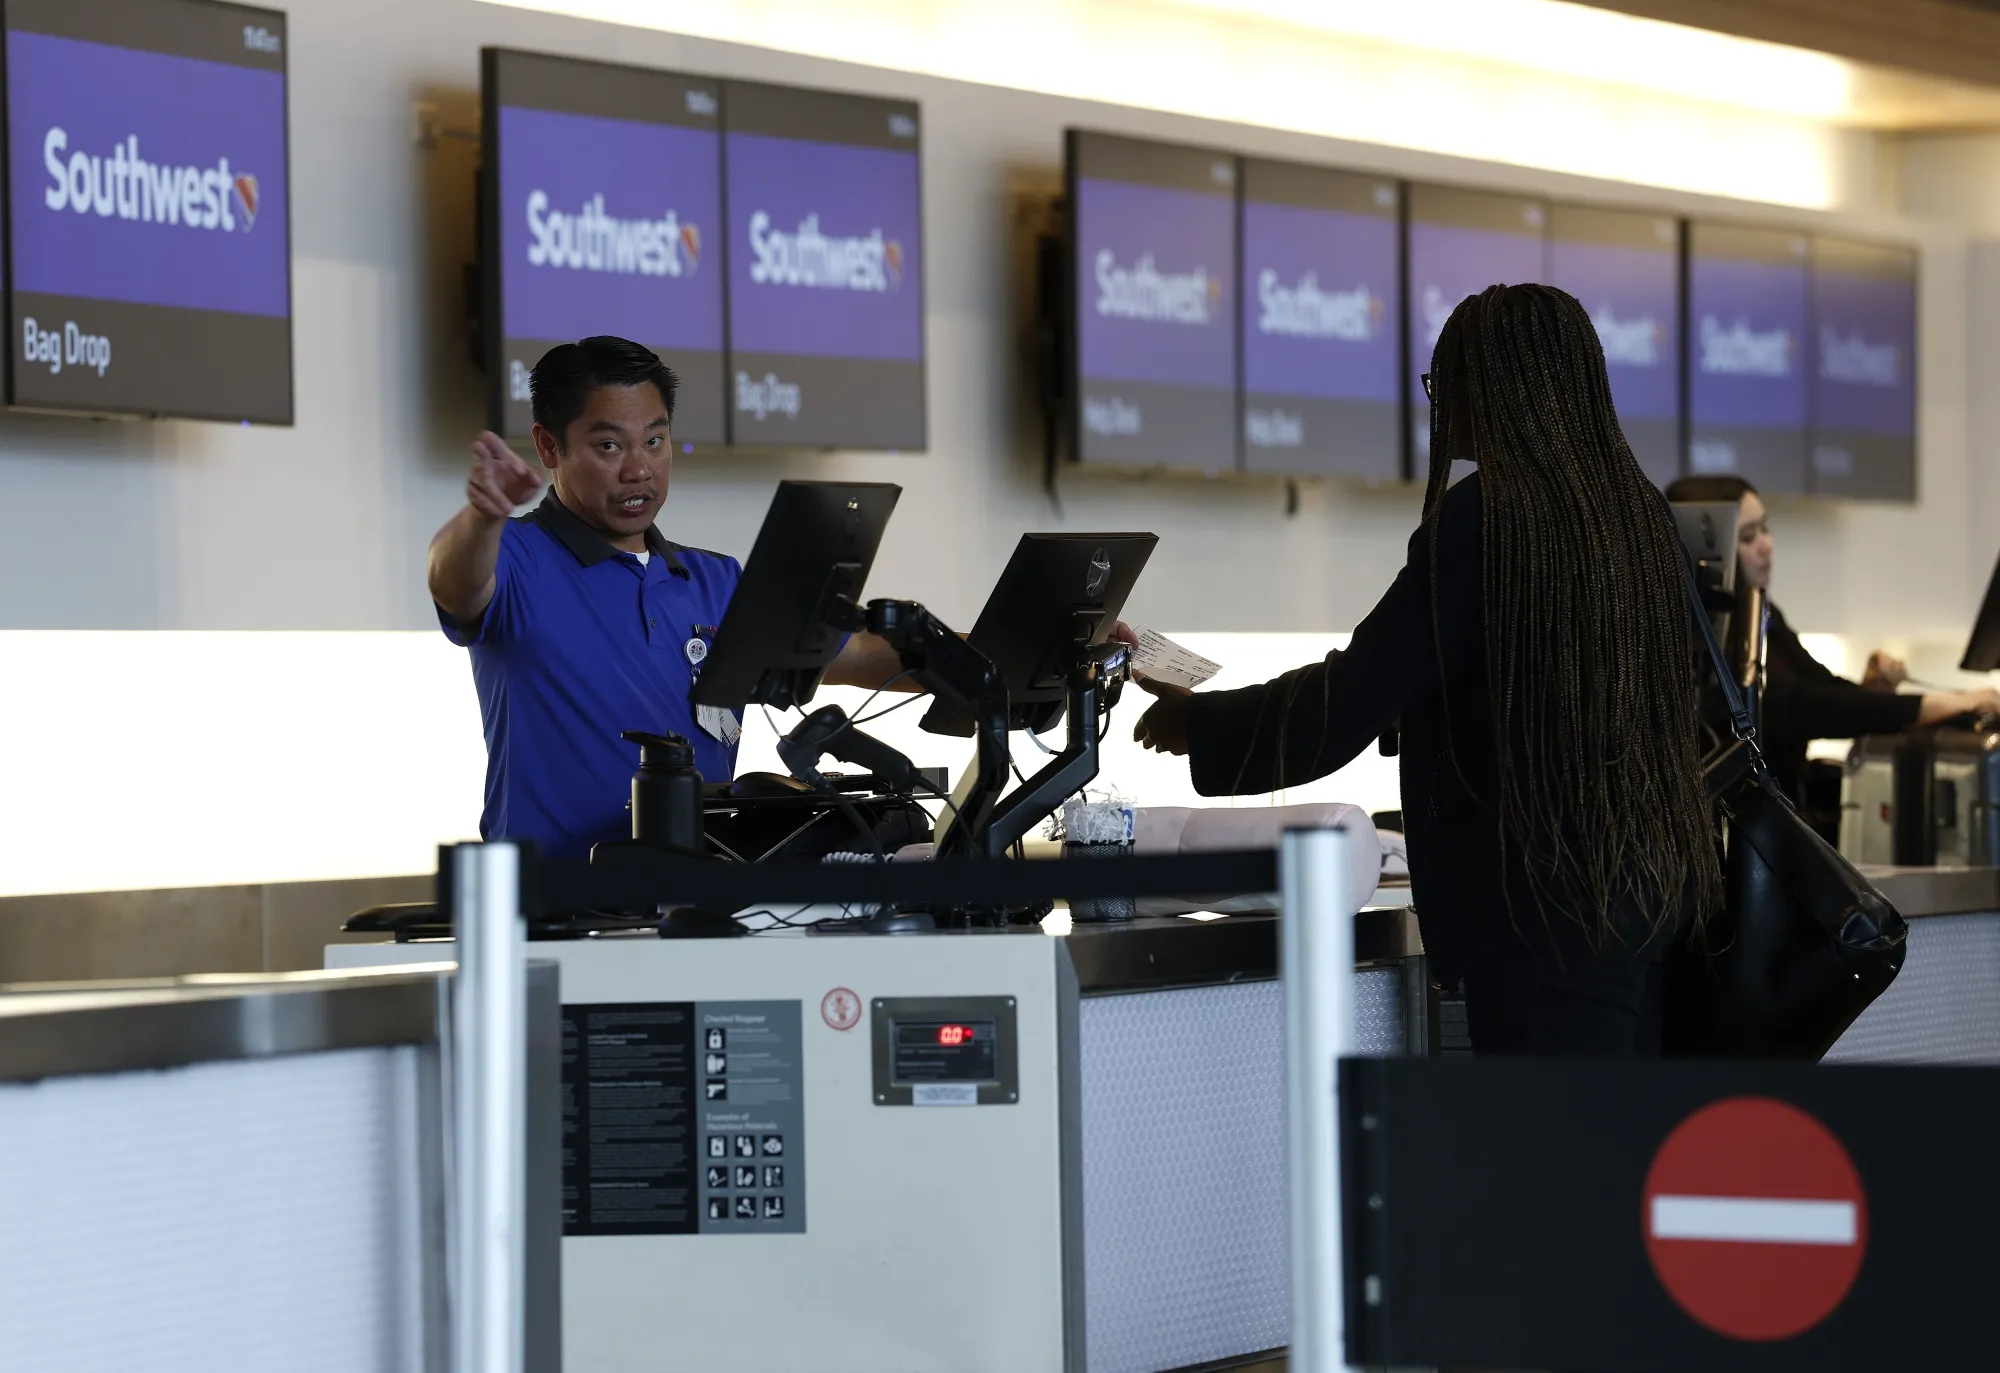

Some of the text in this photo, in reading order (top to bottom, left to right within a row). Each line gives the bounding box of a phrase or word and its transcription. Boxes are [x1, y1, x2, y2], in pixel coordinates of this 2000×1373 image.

[44, 126, 236, 232] Southwest
[526, 189, 682, 278] Southwest
[749, 210, 887, 291] Southwest
[23, 317, 111, 377] Bag Drop
[735, 370, 801, 421] Bag Drop
